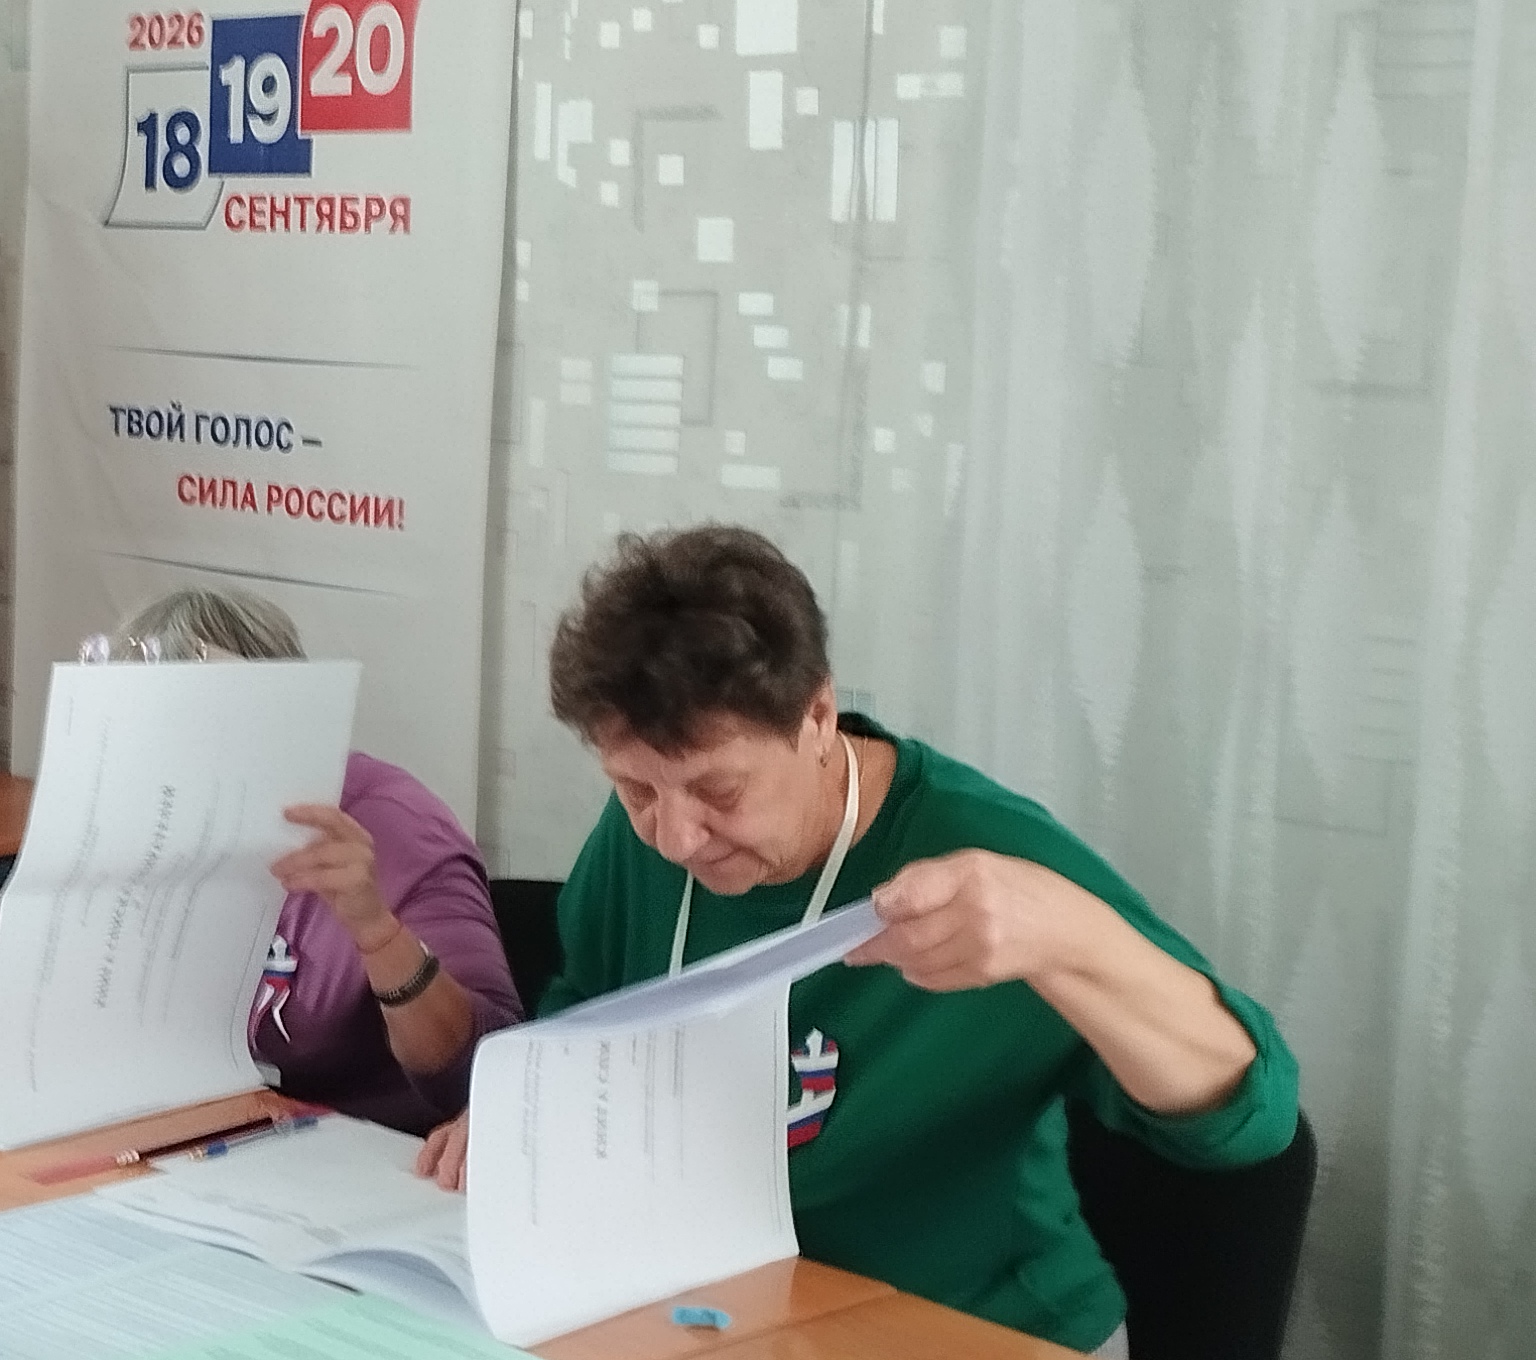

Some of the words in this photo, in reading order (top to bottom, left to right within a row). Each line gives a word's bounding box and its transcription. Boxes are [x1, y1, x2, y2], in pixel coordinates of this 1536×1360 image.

[127, 10, 206, 51] 2026
[310, 2, 406, 98] 20
[218, 52, 293, 145] 19
[136, 110, 202, 193] 18
[223, 193, 412, 234] СЕНТЯБРЯ
[108, 400, 186, 443] ТВОЙ
[194, 413, 294, 453] ГОЛОС
[176, 473, 259, 514] СИЛА
[266, 483, 406, 532] РОССИИ!
